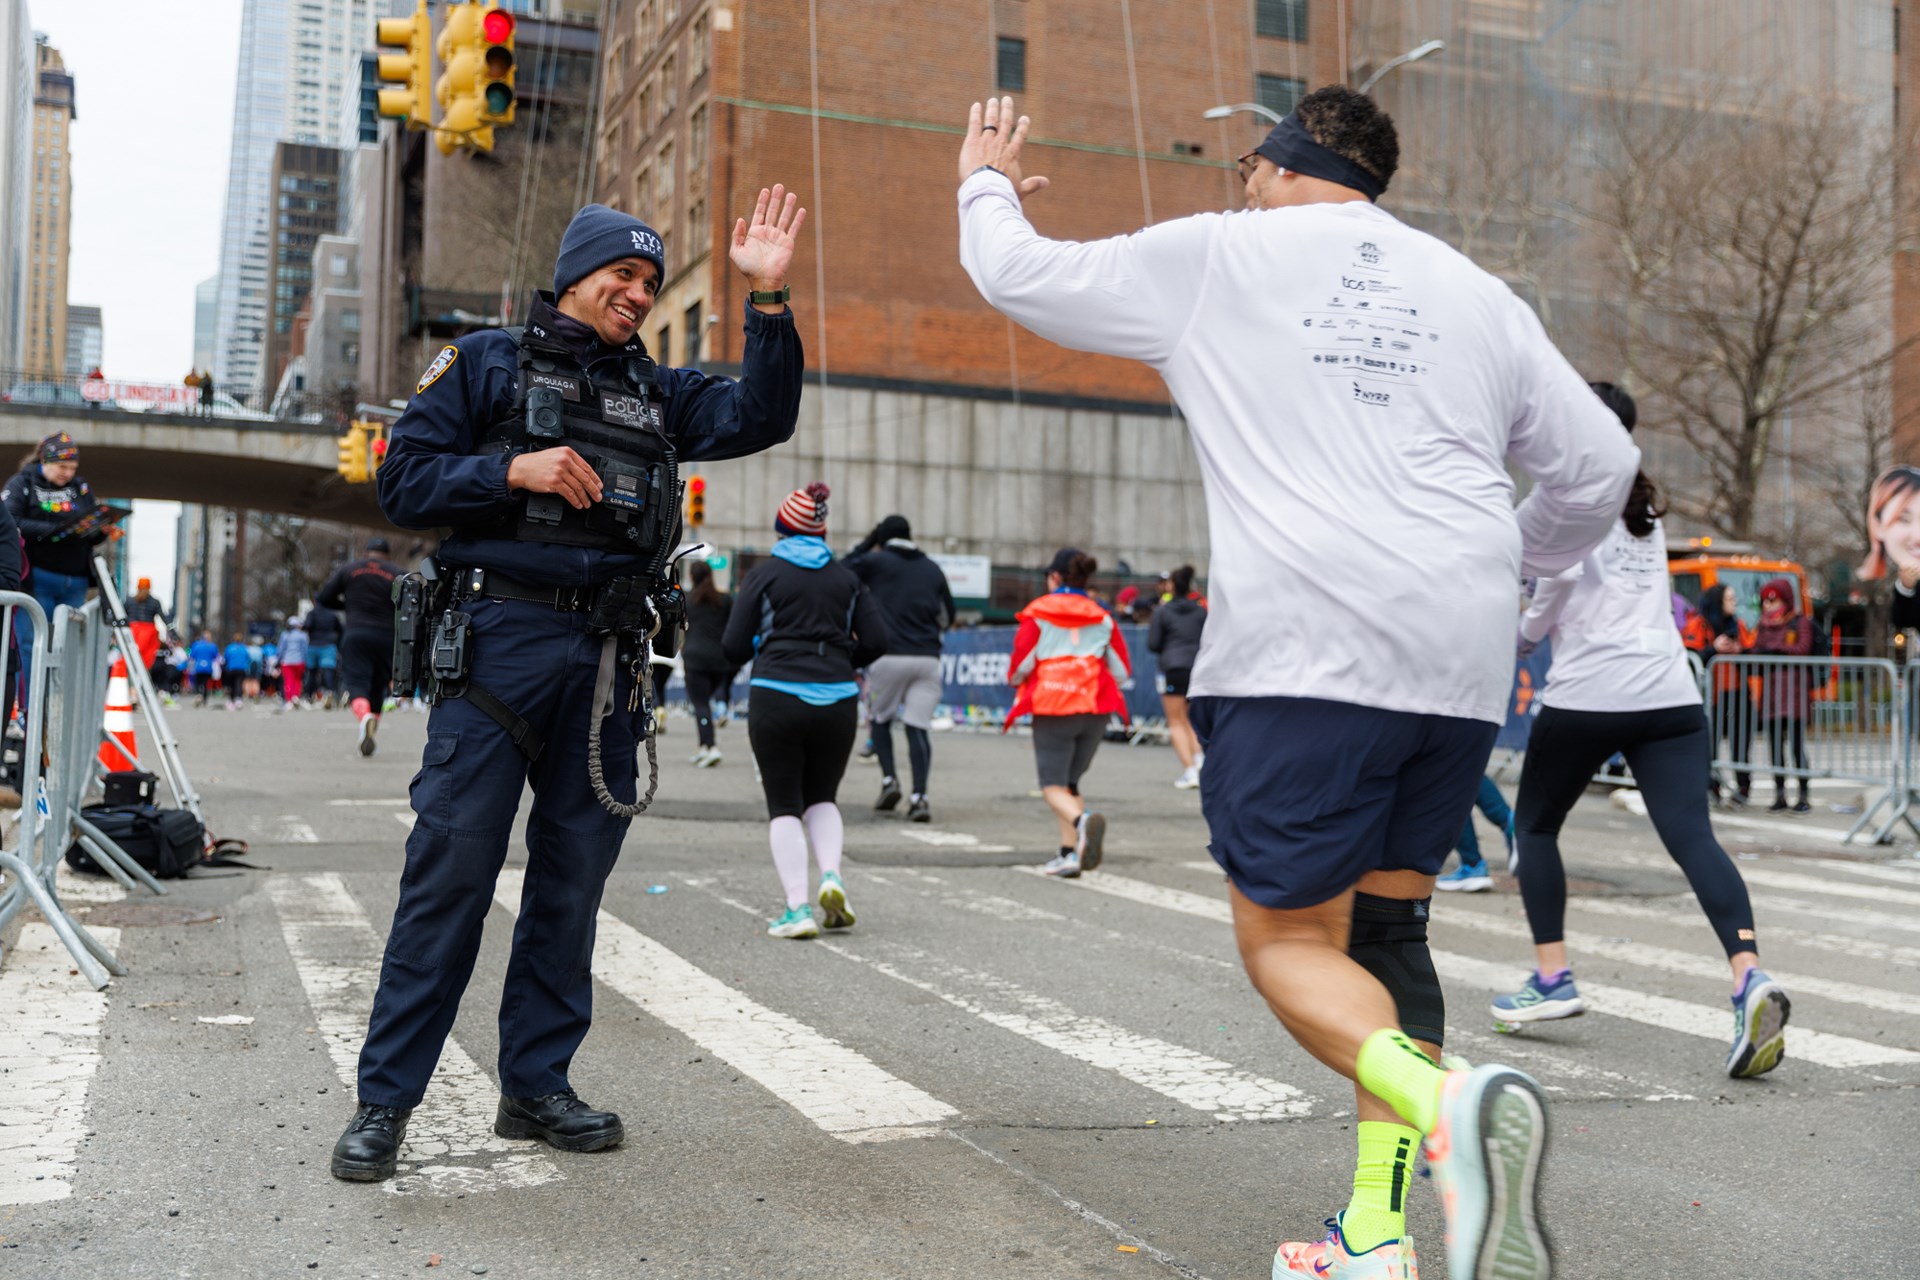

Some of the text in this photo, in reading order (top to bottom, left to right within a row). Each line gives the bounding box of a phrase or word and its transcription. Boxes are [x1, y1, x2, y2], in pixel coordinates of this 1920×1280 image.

[635, 242, 655, 254] ESU
[1342, 276, 1366, 291] tcs
[533, 326, 546, 338] K9
[625, 344, 638, 352] K9
[533, 375, 575, 390] URQUIAGA
[83, 381, 110, 401] GO
[1362, 391, 1390, 402] NYRR
[621, 395, 642, 406] NYPD
[604, 398, 660, 420] POLICE
